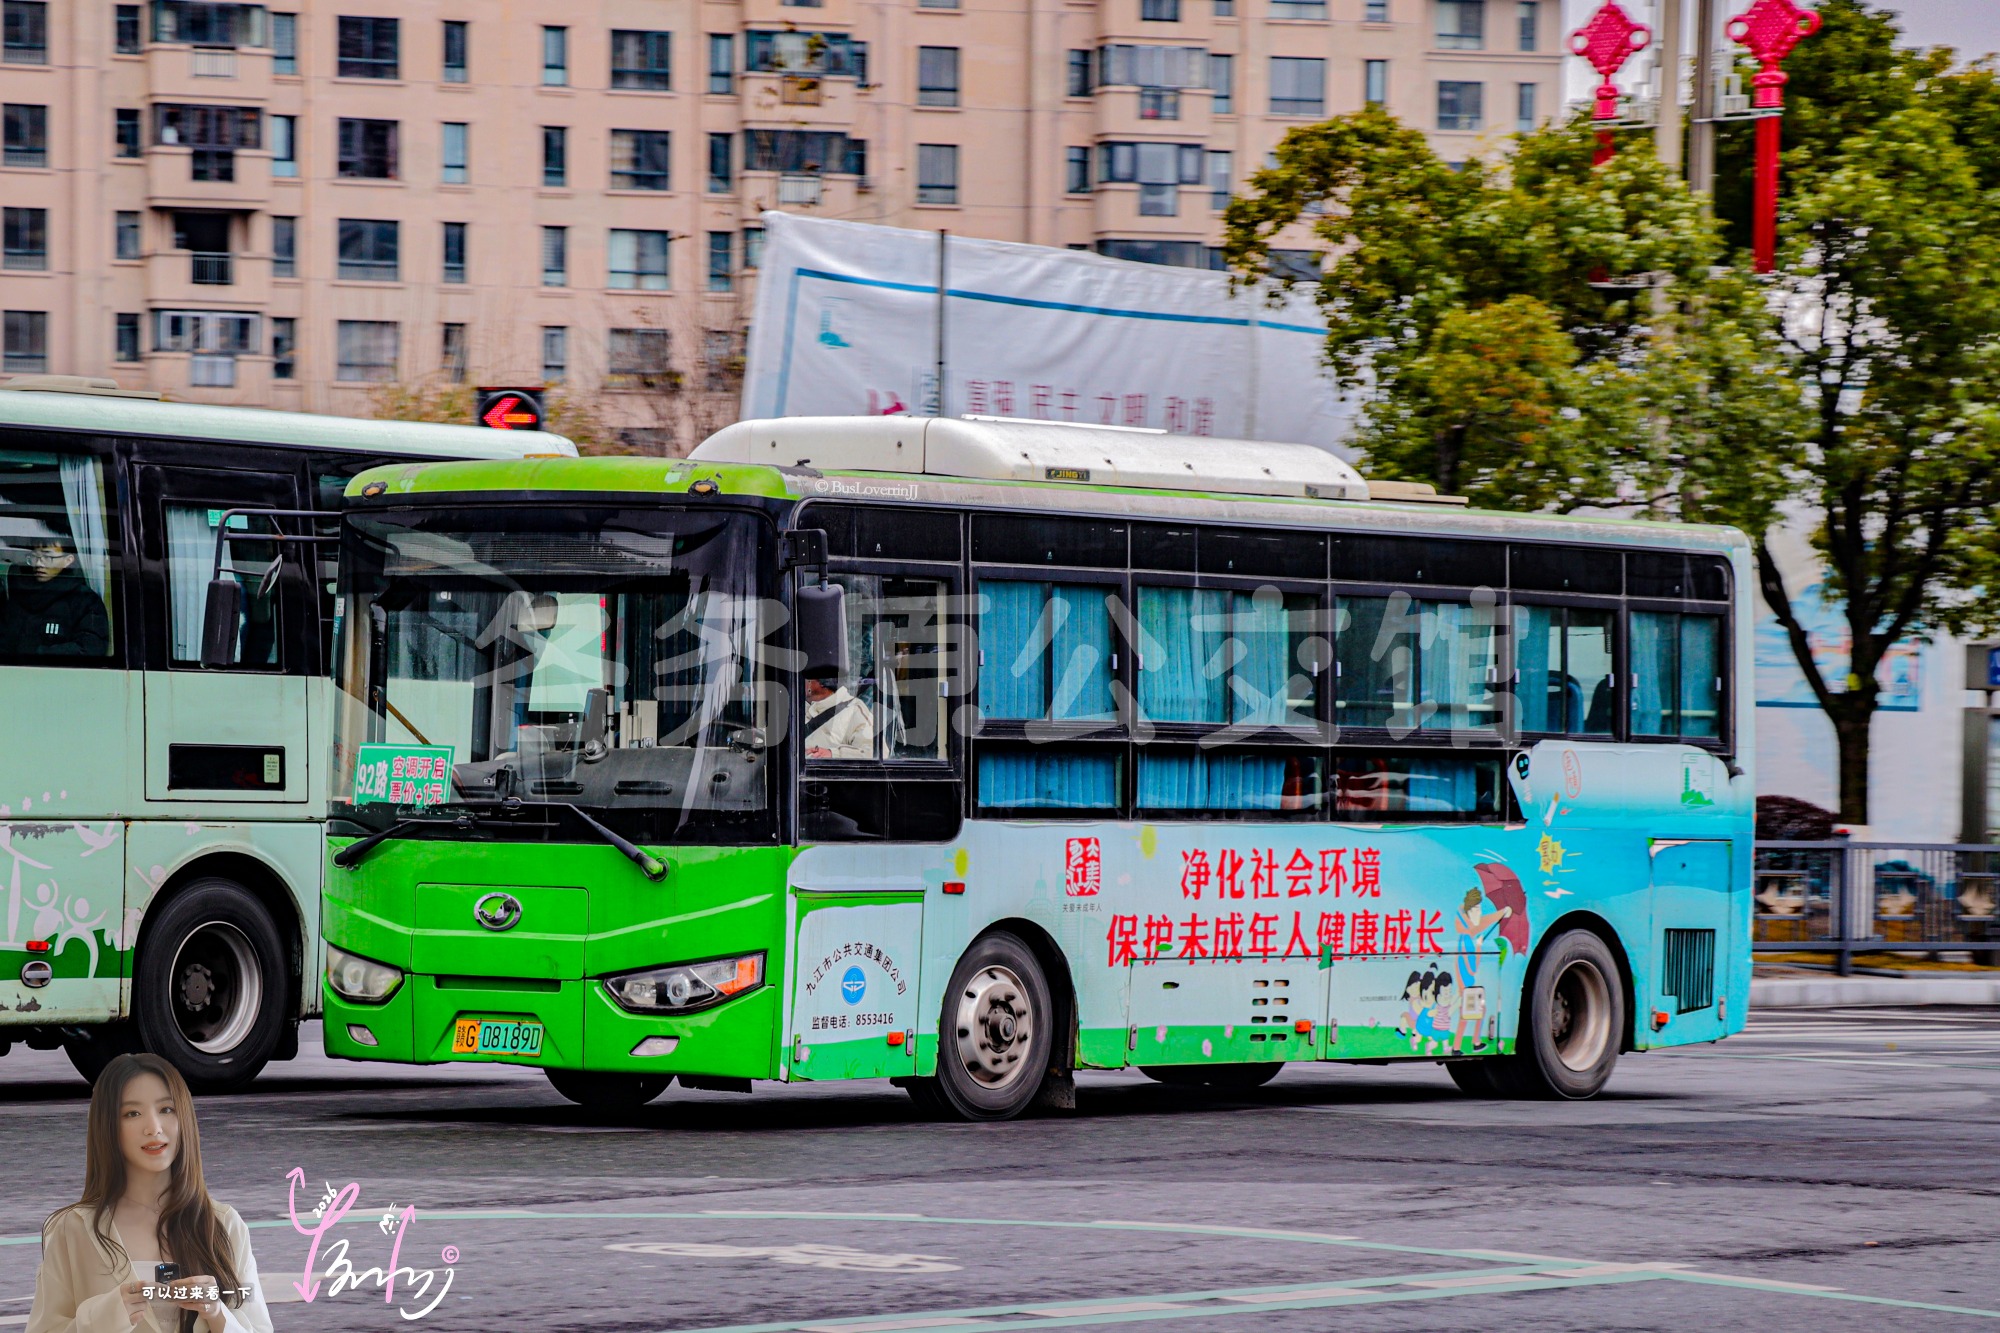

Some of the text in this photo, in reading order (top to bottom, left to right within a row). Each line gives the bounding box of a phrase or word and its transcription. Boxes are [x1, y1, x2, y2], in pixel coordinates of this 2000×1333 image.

[392, 756, 446, 780] 空调开启
[1180, 848, 1381, 900] 净化社会环境
[1062, 903, 1102, 912] 关爱未成年人
[1106, 909, 1444, 968] 保护未成年人健康成长
[806, 942, 907, 996] 九江市公共交通集团公司
